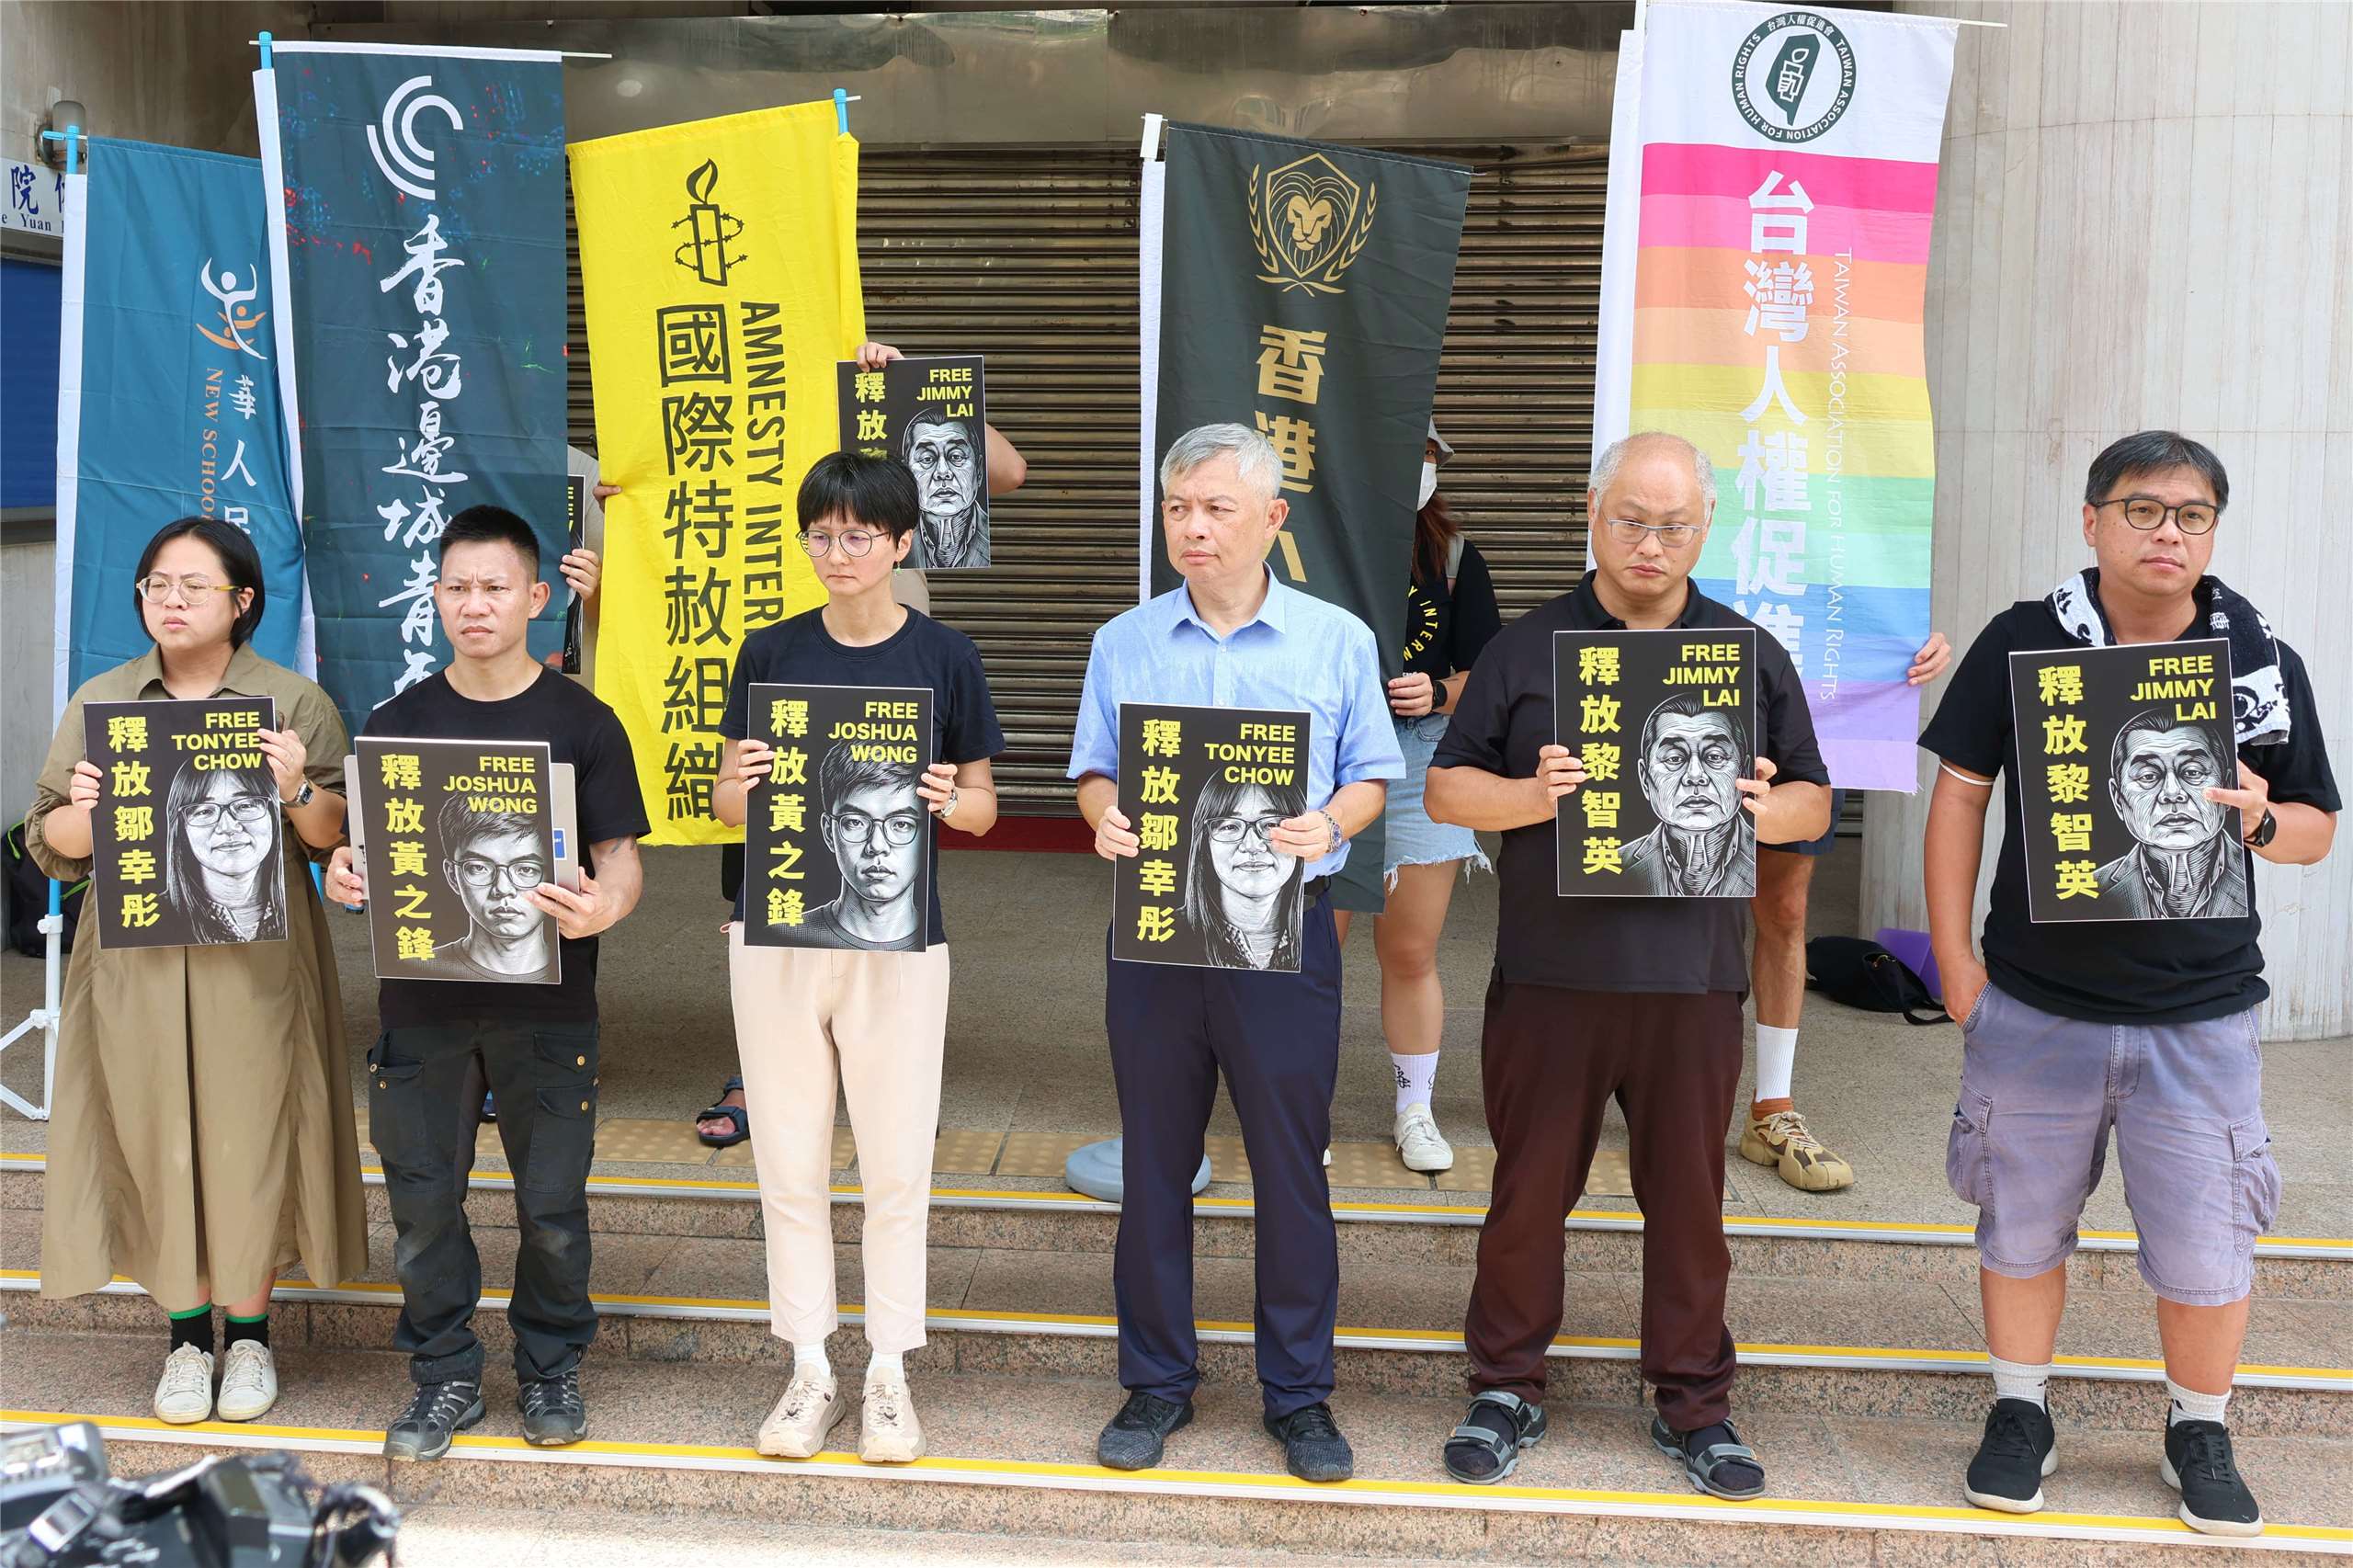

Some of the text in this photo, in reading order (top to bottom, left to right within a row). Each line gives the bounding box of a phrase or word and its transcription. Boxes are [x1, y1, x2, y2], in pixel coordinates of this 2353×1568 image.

[1768, 15, 1835, 37] 台灣人權促進會
[1735, 33, 1853, 140] TAIWAN ASSOCIATION FOR HUMAN RIGHTS
[20, 213, 51, 232] Yuan
[929, 369, 972, 382] FREE
[204, 367, 224, 423] NEW
[916, 385, 972, 401] JIMMY
[946, 403, 974, 418] LAI
[741, 301, 786, 635] AMNESTY INTER
[1820, 247, 1852, 702] TAIWAN ASSOCIATION FOR HUMAN RIGHTS
[656, 303, 734, 822] 國際特赦組織
[1681, 644, 1740, 662] FREE
[2148, 655, 2213, 676] FREE
[1663, 666, 1740, 685] JIMMY
[1703, 689, 1740, 707] LAI
[2130, 678, 2214, 701] JIMMY
[865, 701, 918, 719] FREE
[2175, 701, 2217, 722] LAI
[205, 711, 260, 729] FREE
[827, 722, 918, 741] JOSHUA
[1240, 723, 1296, 742] FREE
[171, 733, 260, 750] TONYEE
[194, 753, 262, 771] CHOW
[851, 744, 917, 763] WONG
[1204, 743, 1295, 764] TONYEE
[1579, 646, 1623, 875] 釋放黎智英
[479, 756, 535, 773] FREE
[442, 776, 537, 793] JOSHUA
[1224, 766, 1294, 786] CHOW
[2038, 665, 2099, 900] 釋放黎智英
[467, 796, 538, 814] WONG
[767, 699, 809, 926] 釋放黃之鋒
[108, 716, 161, 928] 釋放鄒幸彤
[1137, 719, 1182, 942] 釋放鄒幸彤
[381, 754, 435, 961] 釋放黃之鋒
